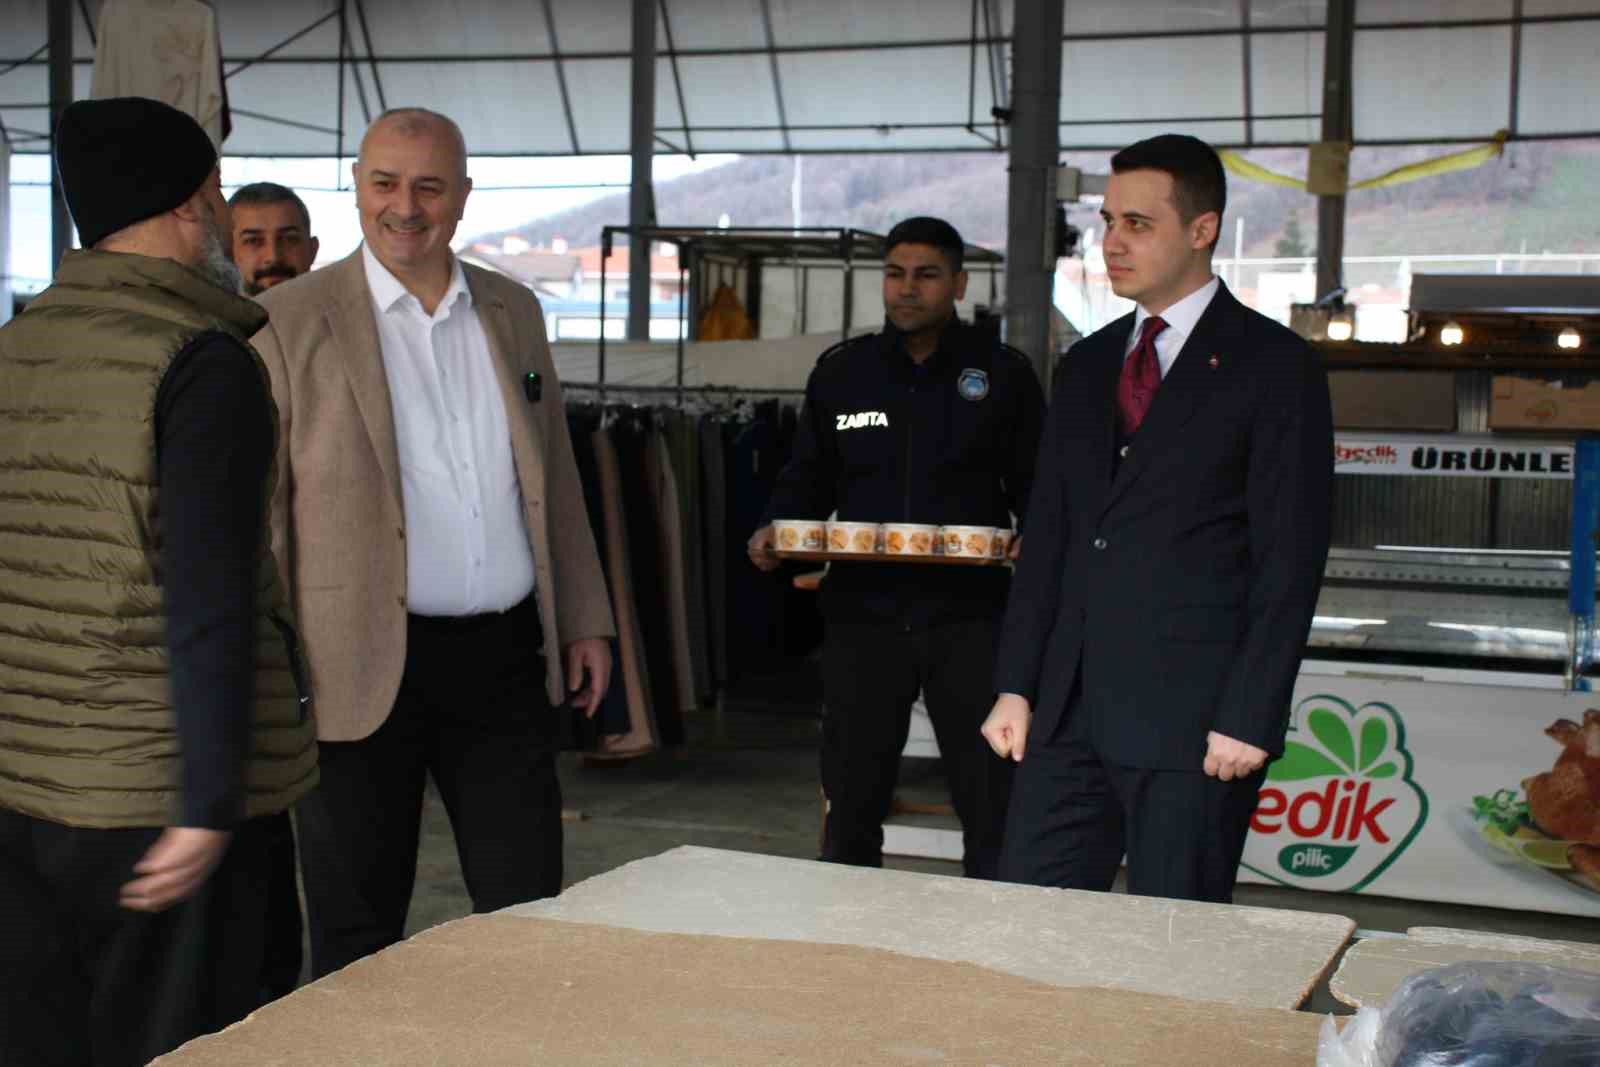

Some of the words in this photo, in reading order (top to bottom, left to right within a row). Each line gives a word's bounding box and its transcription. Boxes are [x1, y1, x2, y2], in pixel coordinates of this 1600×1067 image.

[836, 411, 889, 430] ZABITA
[1410, 446, 1571, 473] ÜRÜNLE
[1291, 847, 1332, 870] piliç
